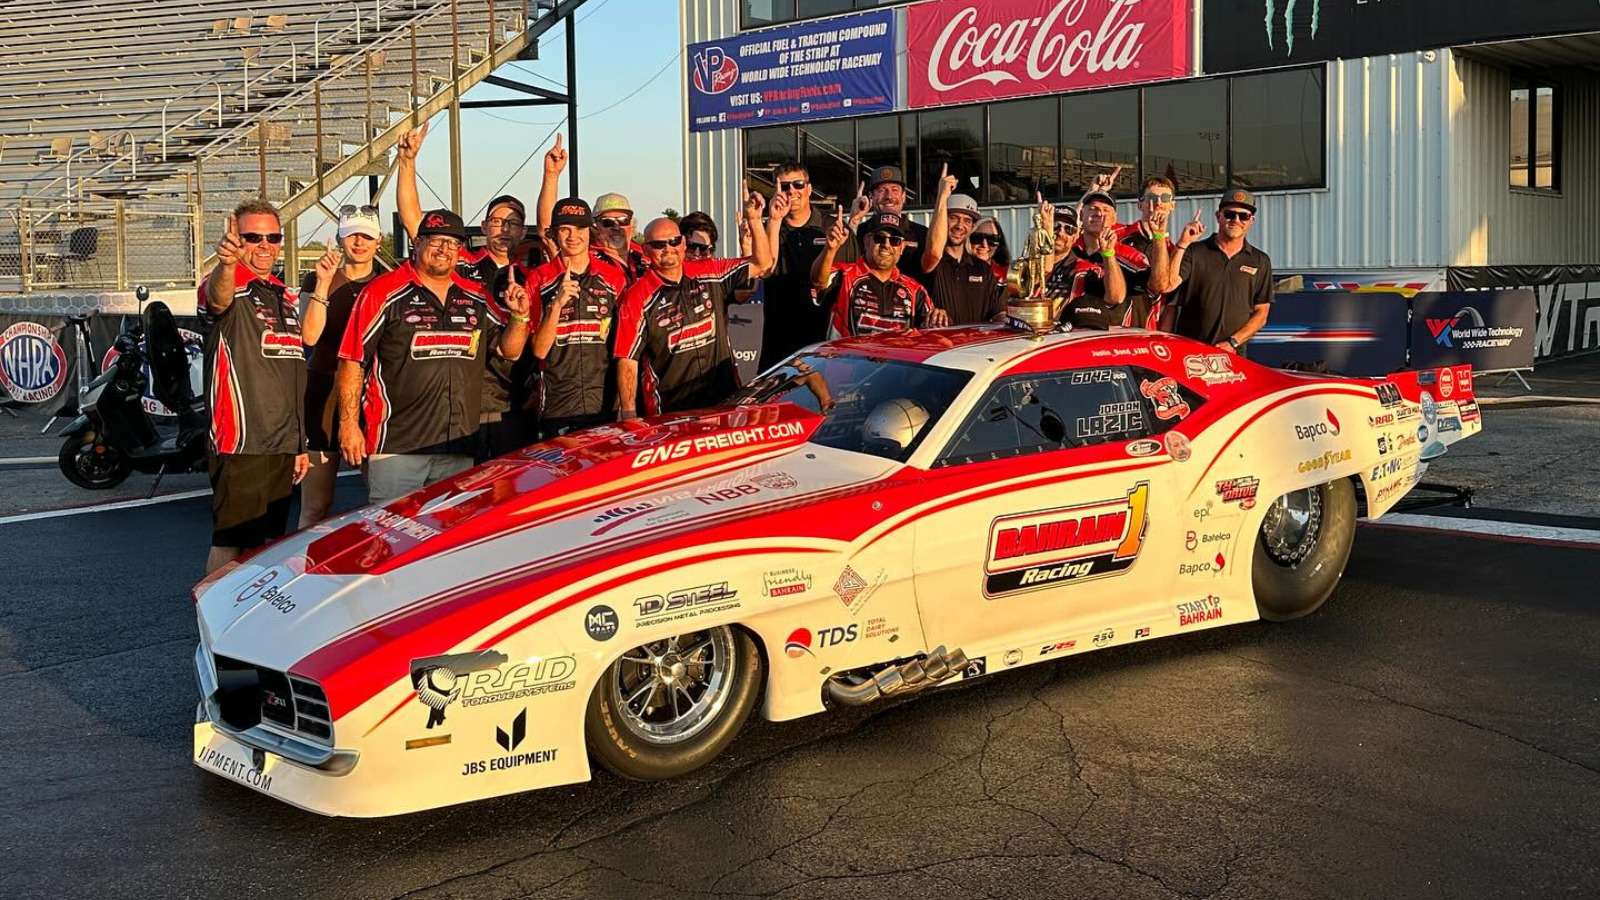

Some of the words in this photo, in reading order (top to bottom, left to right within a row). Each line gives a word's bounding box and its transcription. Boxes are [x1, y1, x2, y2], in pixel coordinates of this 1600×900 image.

[740, 42, 771, 57] OFFICIAL
[773, 38, 789, 53] FUEL
[791, 38, 797, 49] &
[798, 31, 838, 48] TRACTION
[839, 23, 887, 42] COMPOUND
[928, 0, 1145, 91] Coca-Cola
[779, 53, 789, 64] OF
[790, 50, 805, 63] THE
[806, 47, 828, 60] STRIP
[829, 45, 841, 57] AT
[693, 47, 725, 93] VP
[741, 70, 768, 84] WORLD
[769, 66, 789, 79] WIDE
[790, 59, 841, 77] TECHNOLOGY
[842, 53, 882, 70] RACEWAY
[730, 94, 749, 107] VISIT
[750, 91, 763, 105] US:
[1452, 329, 1470, 339] World
[1471, 327, 1487, 338] Wide
[1488, 326, 1524, 338] Technology
[1478, 338, 1513, 348] RACEWAY
[4, 338, 55, 388] NHRA
[1071, 369, 1111, 385] 6042
[1099, 401, 1140, 415] JORDAN
[1375, 413, 1394, 426] RAD
[1077, 411, 1142, 437] LAZIC
[1295, 422, 1327, 441] Bapco
[631, 440, 693, 468] GNS
[694, 422, 804, 453] FREIGHT.COM
[1297, 449, 1352, 473] GOODYEAR
[695, 484, 760, 506] NBB
[994, 511, 1127, 560] BAHRAIN
[1113, 481, 1149, 560] 1
[1202, 532, 1231, 543] Batelco
[1019, 561, 1094, 585] Racing
[1179, 562, 1211, 577] Bapco
[762, 570, 813, 597] friendly
[771, 585, 805, 597] BAHRAIN
[259, 586, 297, 614] Batelco
[665, 581, 738, 611] STEEL
[588, 611, 615, 627] MC
[635, 616, 673, 628] PRECISION
[674, 611, 698, 621] METAL
[699, 603, 741, 615] PROCESSING
[867, 617, 886, 626] TOTAL
[1179, 607, 1222, 626] BAHRAIN
[818, 623, 858, 648] TDS
[865, 627, 899, 639] SOLUTIONS
[866, 624, 886, 632] DAIRY
[461, 655, 577, 698] RAD
[462, 691, 515, 708] TORQUE
[516, 680, 576, 698] SYSTEMS
[462, 760, 486, 776] JBS
[490, 749, 558, 771] EQUIPMENT
